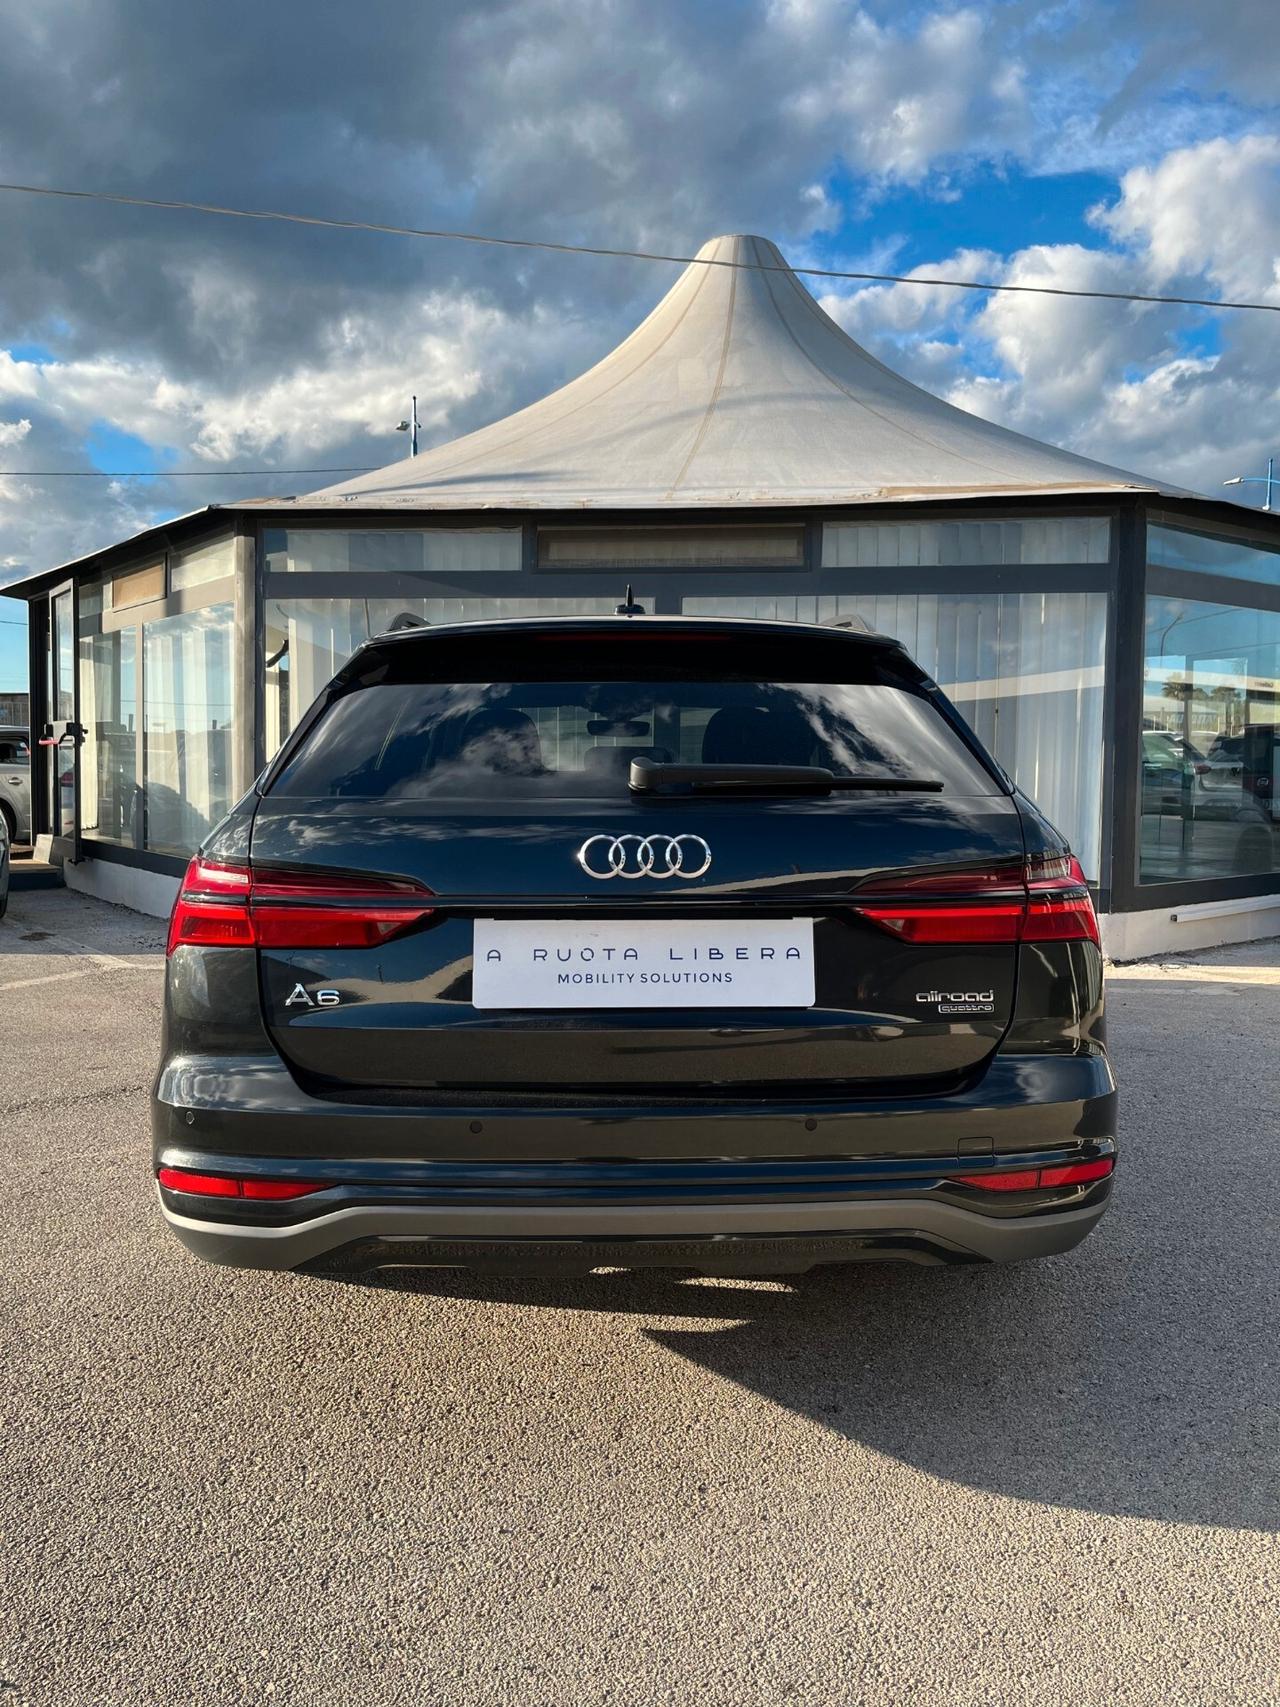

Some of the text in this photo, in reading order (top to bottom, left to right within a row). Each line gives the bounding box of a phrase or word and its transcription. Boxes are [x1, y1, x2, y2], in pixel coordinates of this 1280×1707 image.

[486, 947, 801, 962] A RUOTA LIBERA
[557, 972, 733, 984] MOBILITY SOLUTIONS
[285, 982, 340, 1006] A6
[915, 989, 994, 1002] allroad
[941, 1004, 992, 1013] quattro
